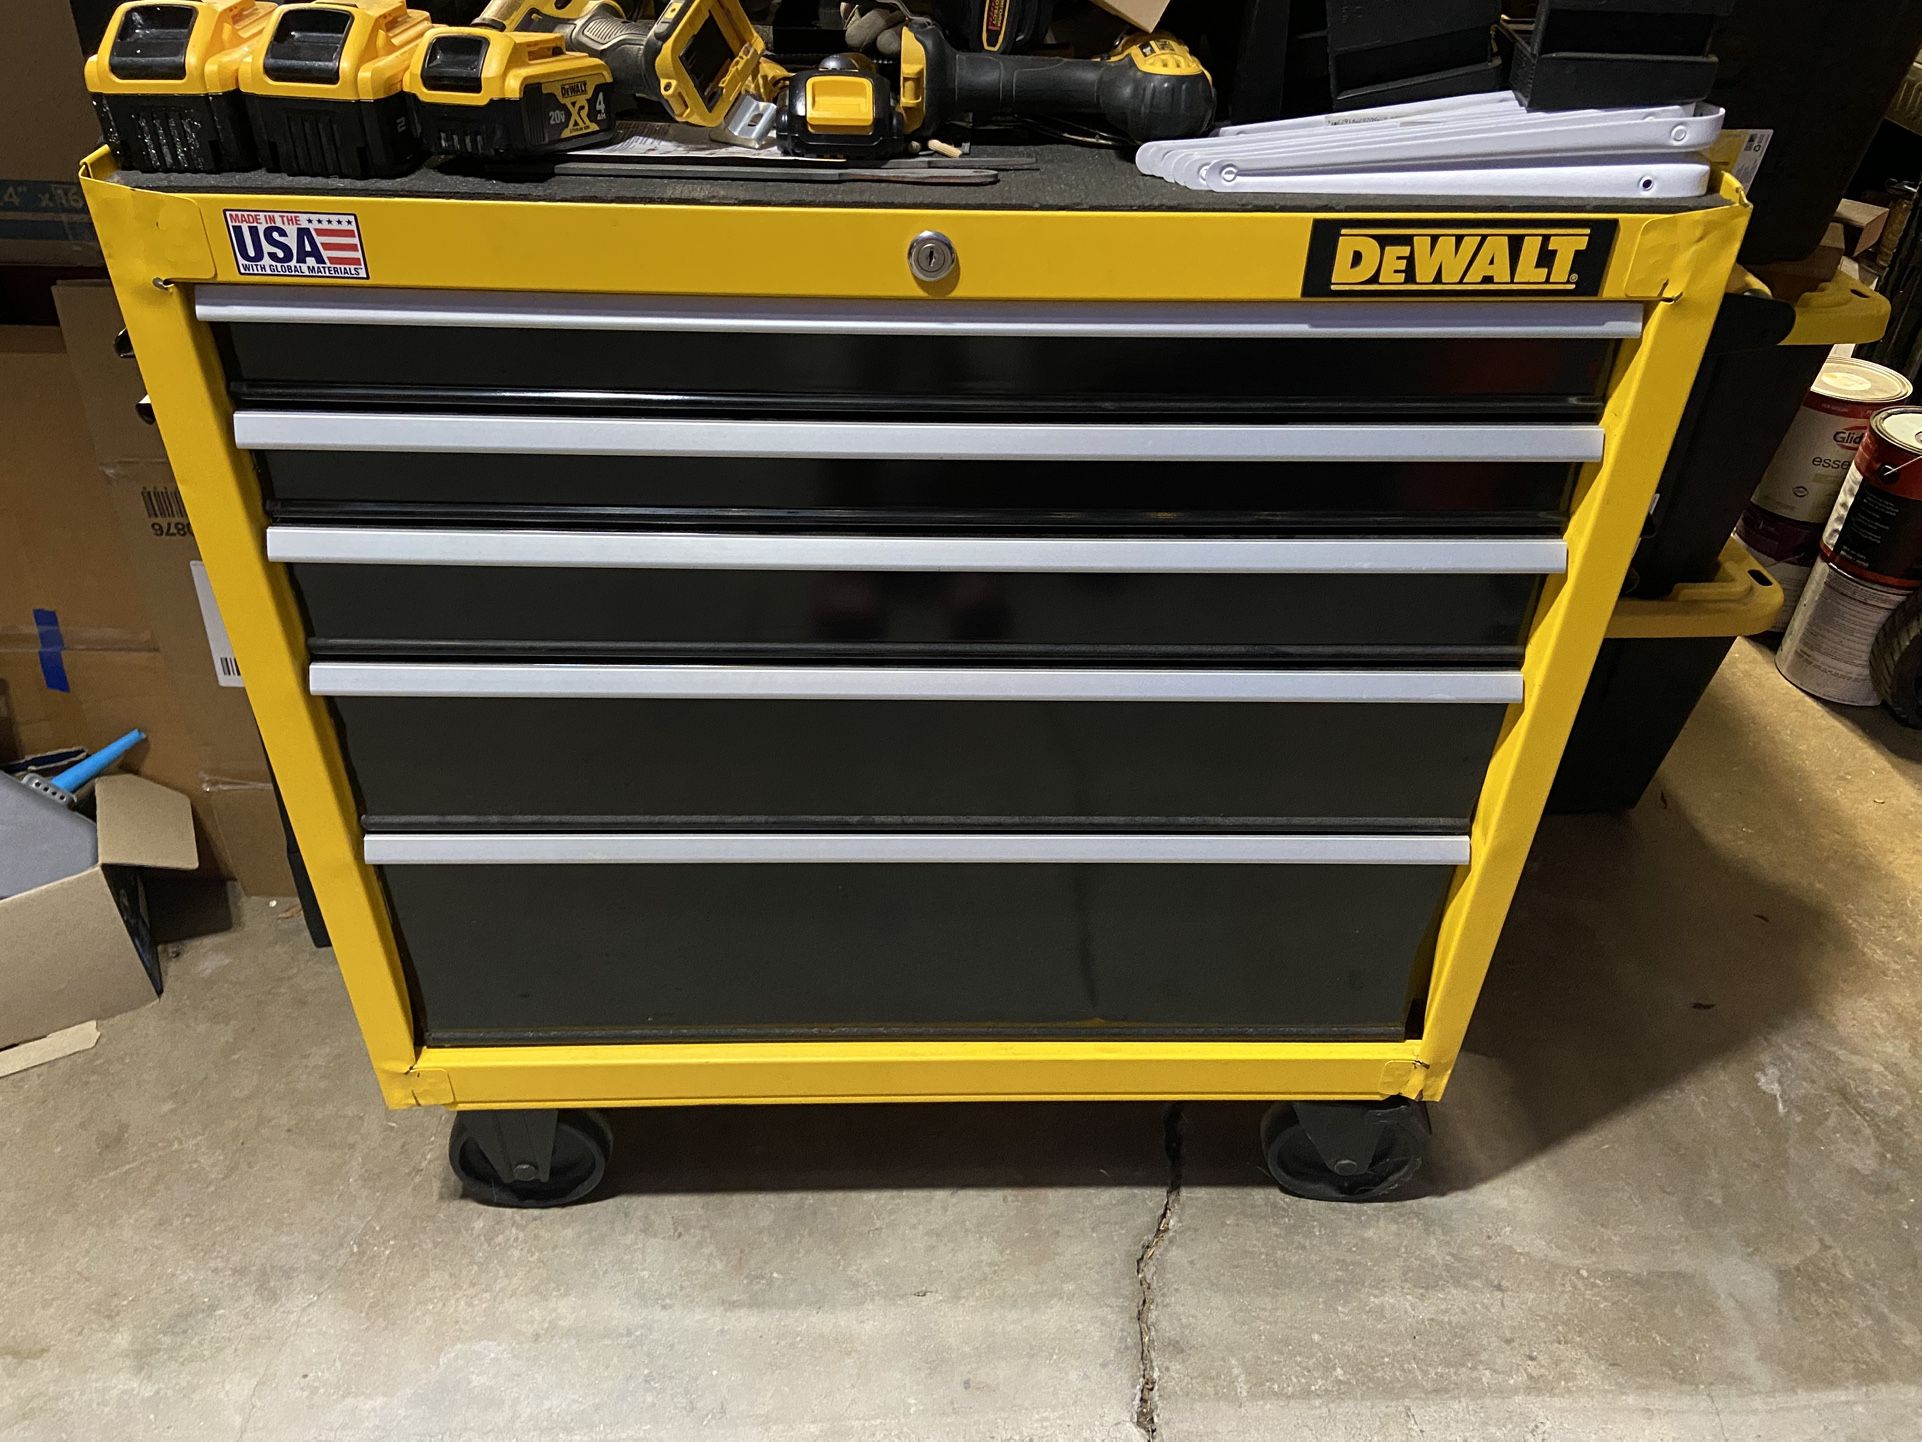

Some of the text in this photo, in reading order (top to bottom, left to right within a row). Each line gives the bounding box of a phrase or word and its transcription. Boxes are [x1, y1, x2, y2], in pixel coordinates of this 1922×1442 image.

[596, 92, 605, 113] 4
[566, 101, 590, 128] XR
[229, 213, 302, 226] MADE IN THE
[231, 225, 327, 265] USA
[241, 263, 363, 276] WITH GLOBAL MATERIALS
